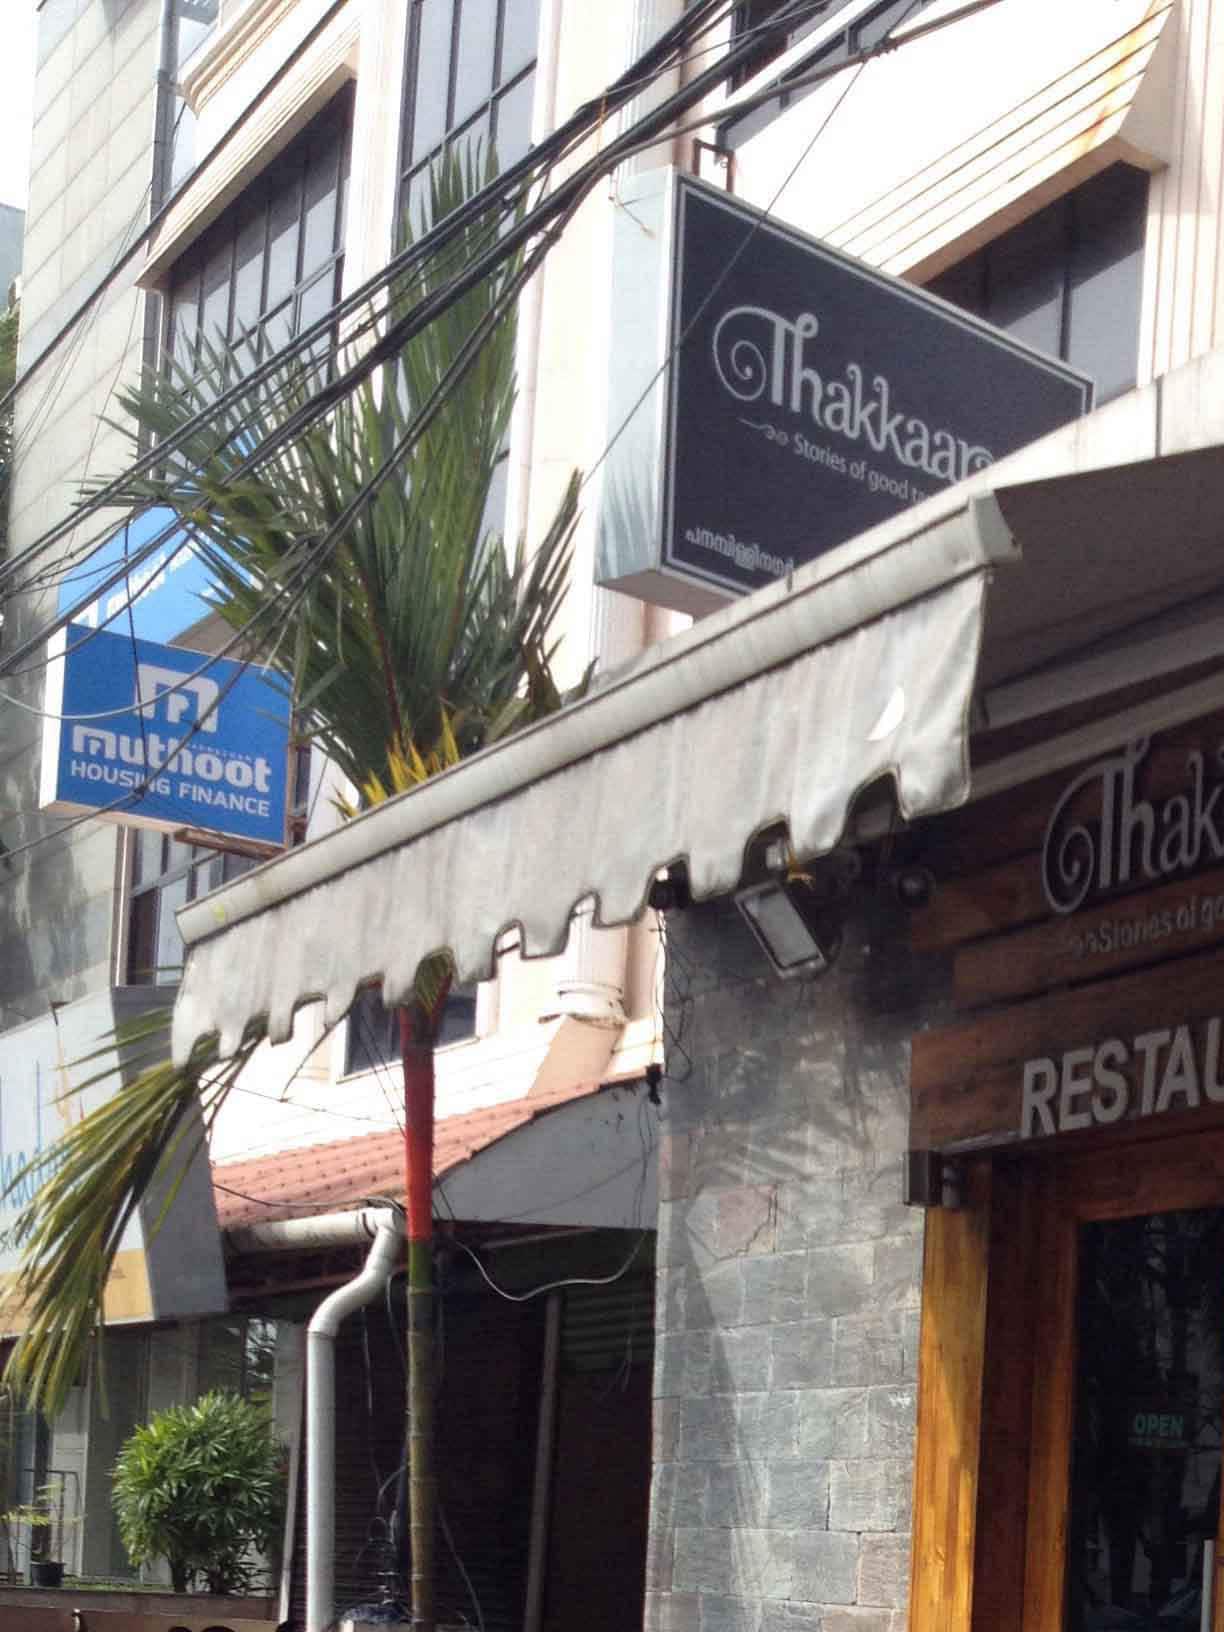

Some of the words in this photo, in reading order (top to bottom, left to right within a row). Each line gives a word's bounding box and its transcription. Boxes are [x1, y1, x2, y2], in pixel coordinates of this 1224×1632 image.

[713, 306, 994, 484] Thakkaar
[794, 433, 848, 474] Stories
[850, 461, 867, 481] of
[868, 471, 909, 499] good
[71, 759, 171, 796] HOUSING
[179, 781, 271, 817] FINANCE
[72, 725, 272, 792] muthoot
[1133, 1413, 1184, 1438] OPEN
